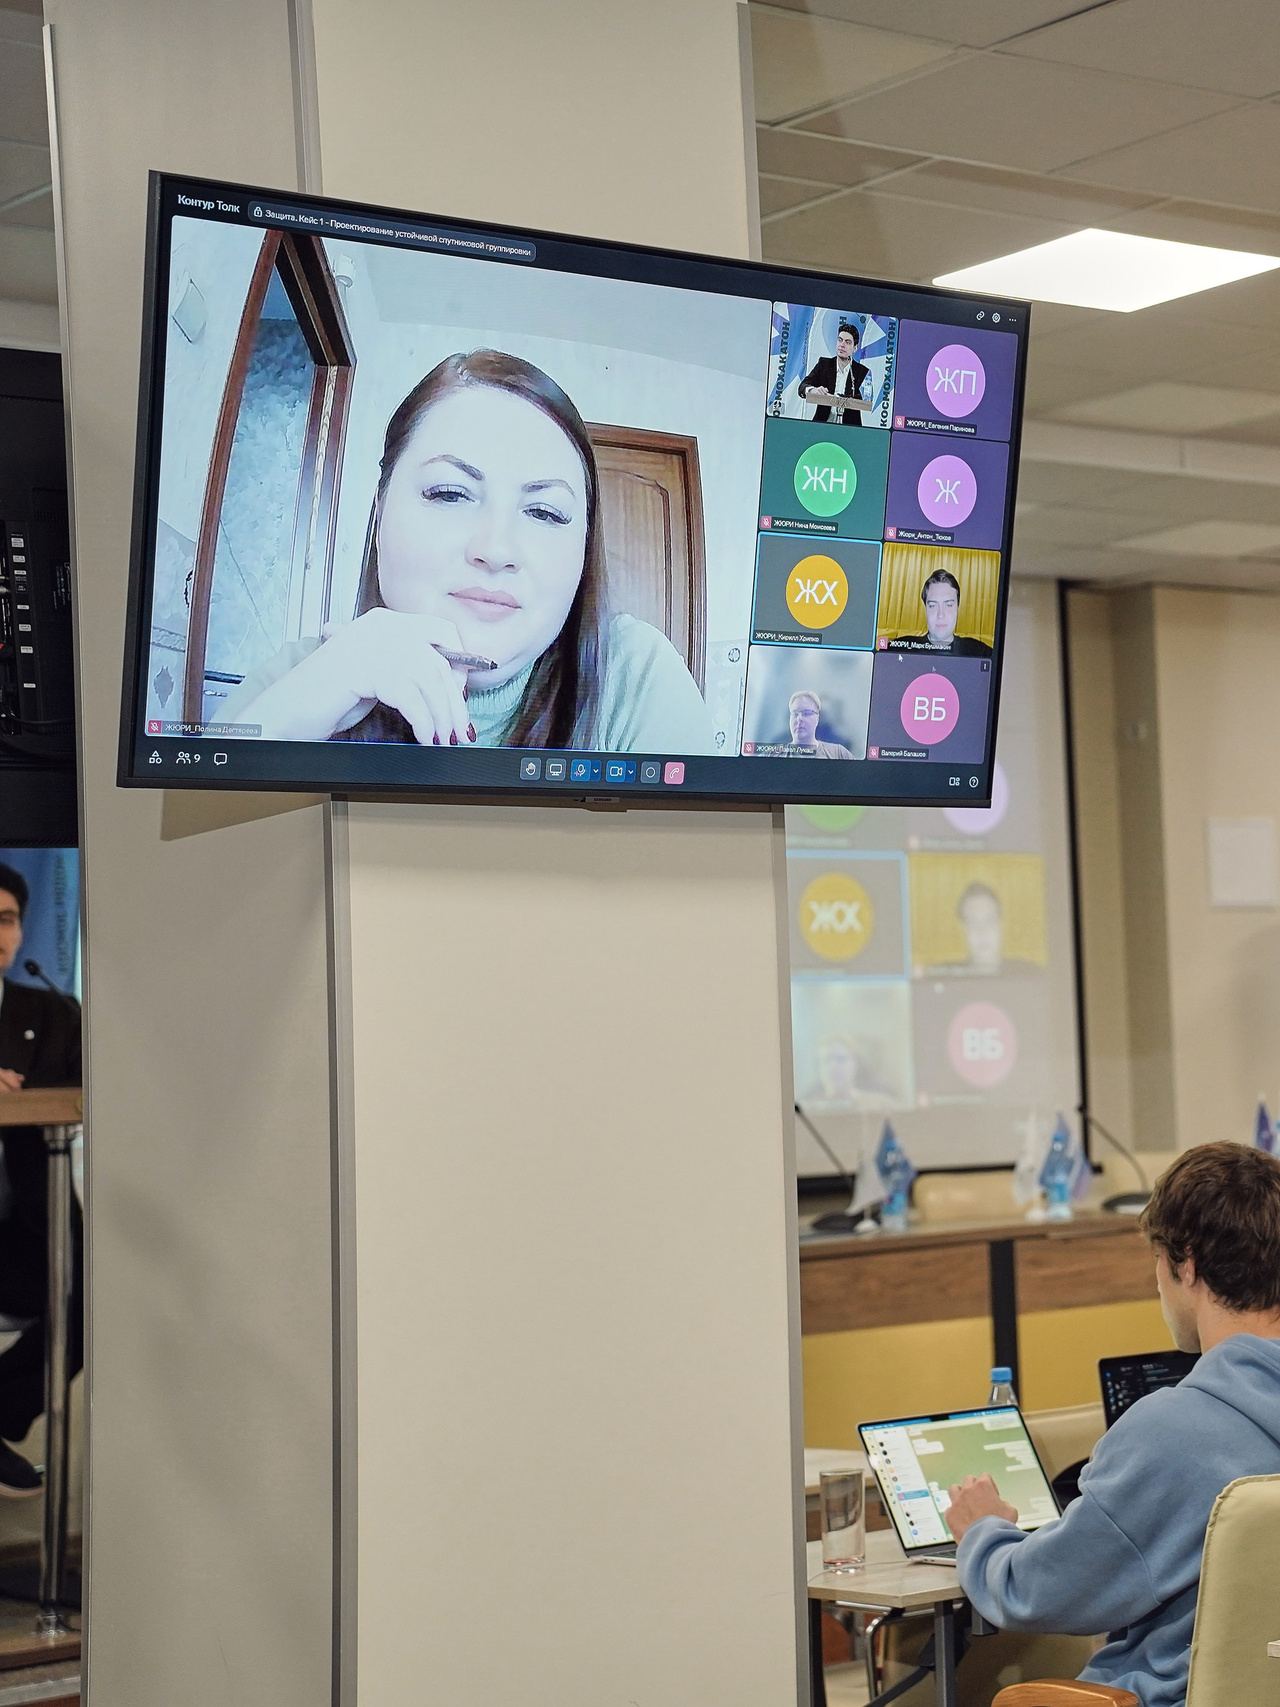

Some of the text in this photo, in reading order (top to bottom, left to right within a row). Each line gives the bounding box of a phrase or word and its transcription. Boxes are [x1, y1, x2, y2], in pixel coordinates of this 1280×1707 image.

[177, 194, 240, 213] Контур Толк
[265, 209, 298, 222] Защита.
[299, 214, 318, 225] Кейс
[330, 219, 394, 236] Проектирование
[394, 230, 438, 243] устойчивой
[438, 236, 485, 250] спутниковой
[485, 243, 531, 257] группировки
[880, 321, 897, 427] КОСМОХАКАТОН
[933, 366, 977, 396] ЖП
[801, 465, 848, 494] ЖН
[934, 478, 961, 505] Ж
[773, 519, 795, 528] ЖЮРИ
[795, 521, 808, 529] Нина
[793, 577, 839, 606] ЖХ
[913, 696, 946, 722] ВБ
[165, 723, 222, 734] ЖЮРИ_Полина
[193, 753, 201, 764] 9
[881, 749, 903, 758] Валерий
